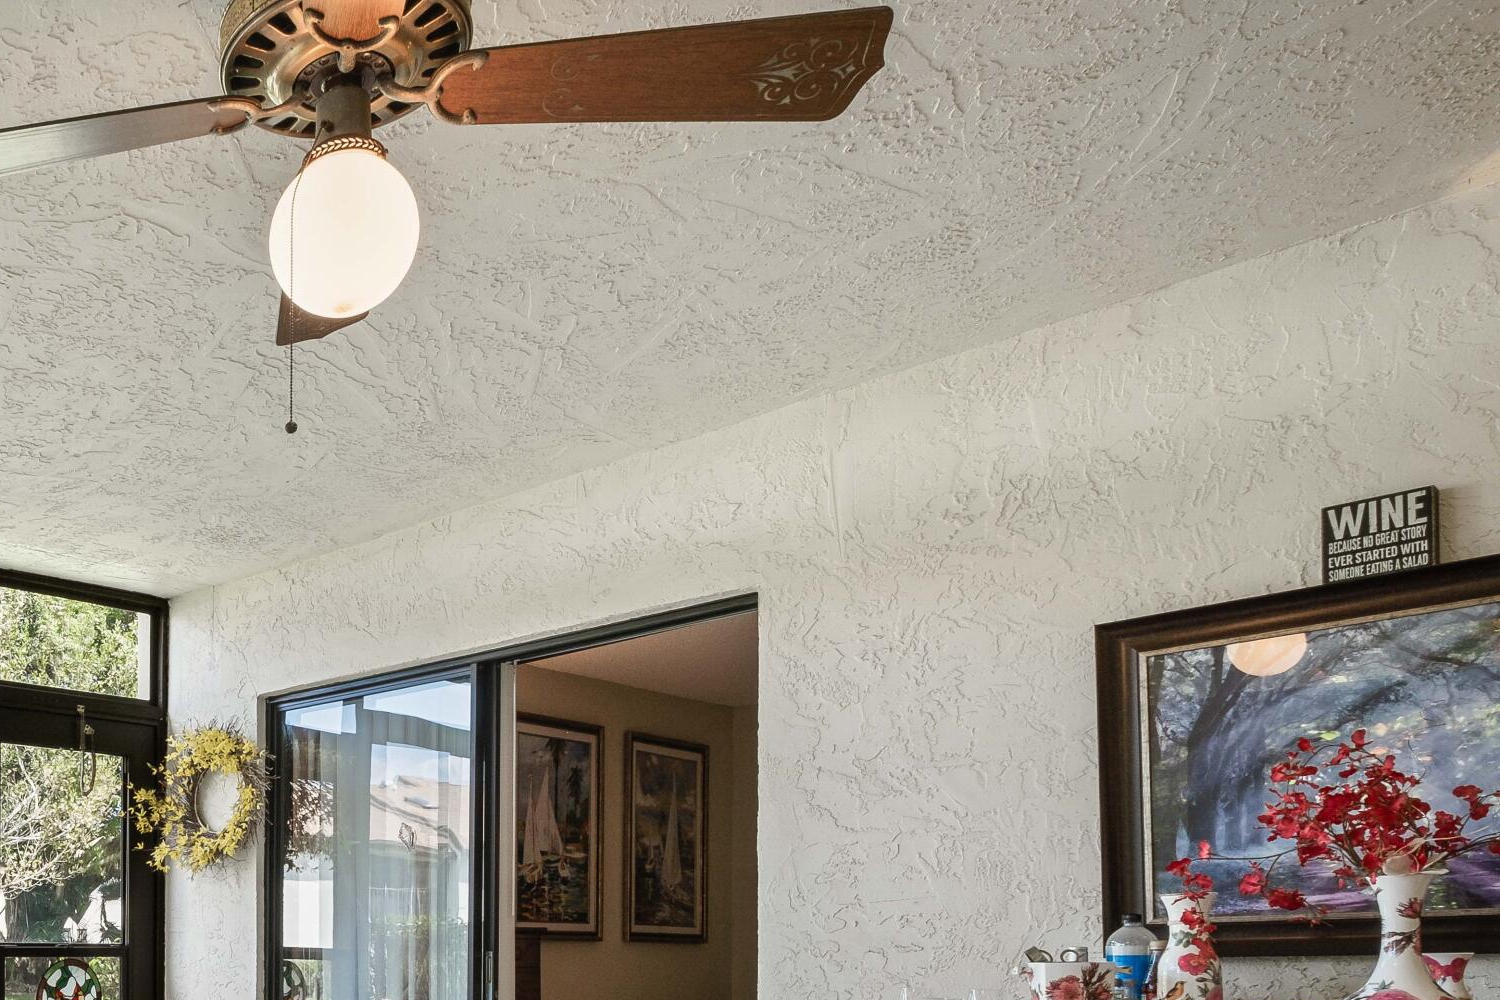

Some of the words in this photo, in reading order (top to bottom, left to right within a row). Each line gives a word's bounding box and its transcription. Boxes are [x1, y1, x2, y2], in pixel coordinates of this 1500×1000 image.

[1328, 490, 1428, 540] WINE
[1329, 538, 1361, 553] BECAUSE
[1363, 535, 1373, 548] NO
[1376, 530, 1399, 545] GREAT
[1401, 524, 1427, 540] STORY
[1329, 555, 1352, 568] EVER
[1355, 546, 1397, 563] STARTED
[1401, 540, 1428, 554] WITH
[1329, 566, 1365, 582] SOMEONE
[1366, 559, 1393, 575] EATING
[1395, 559, 1401, 570] A
[1403, 553, 1428, 568] SALAD
